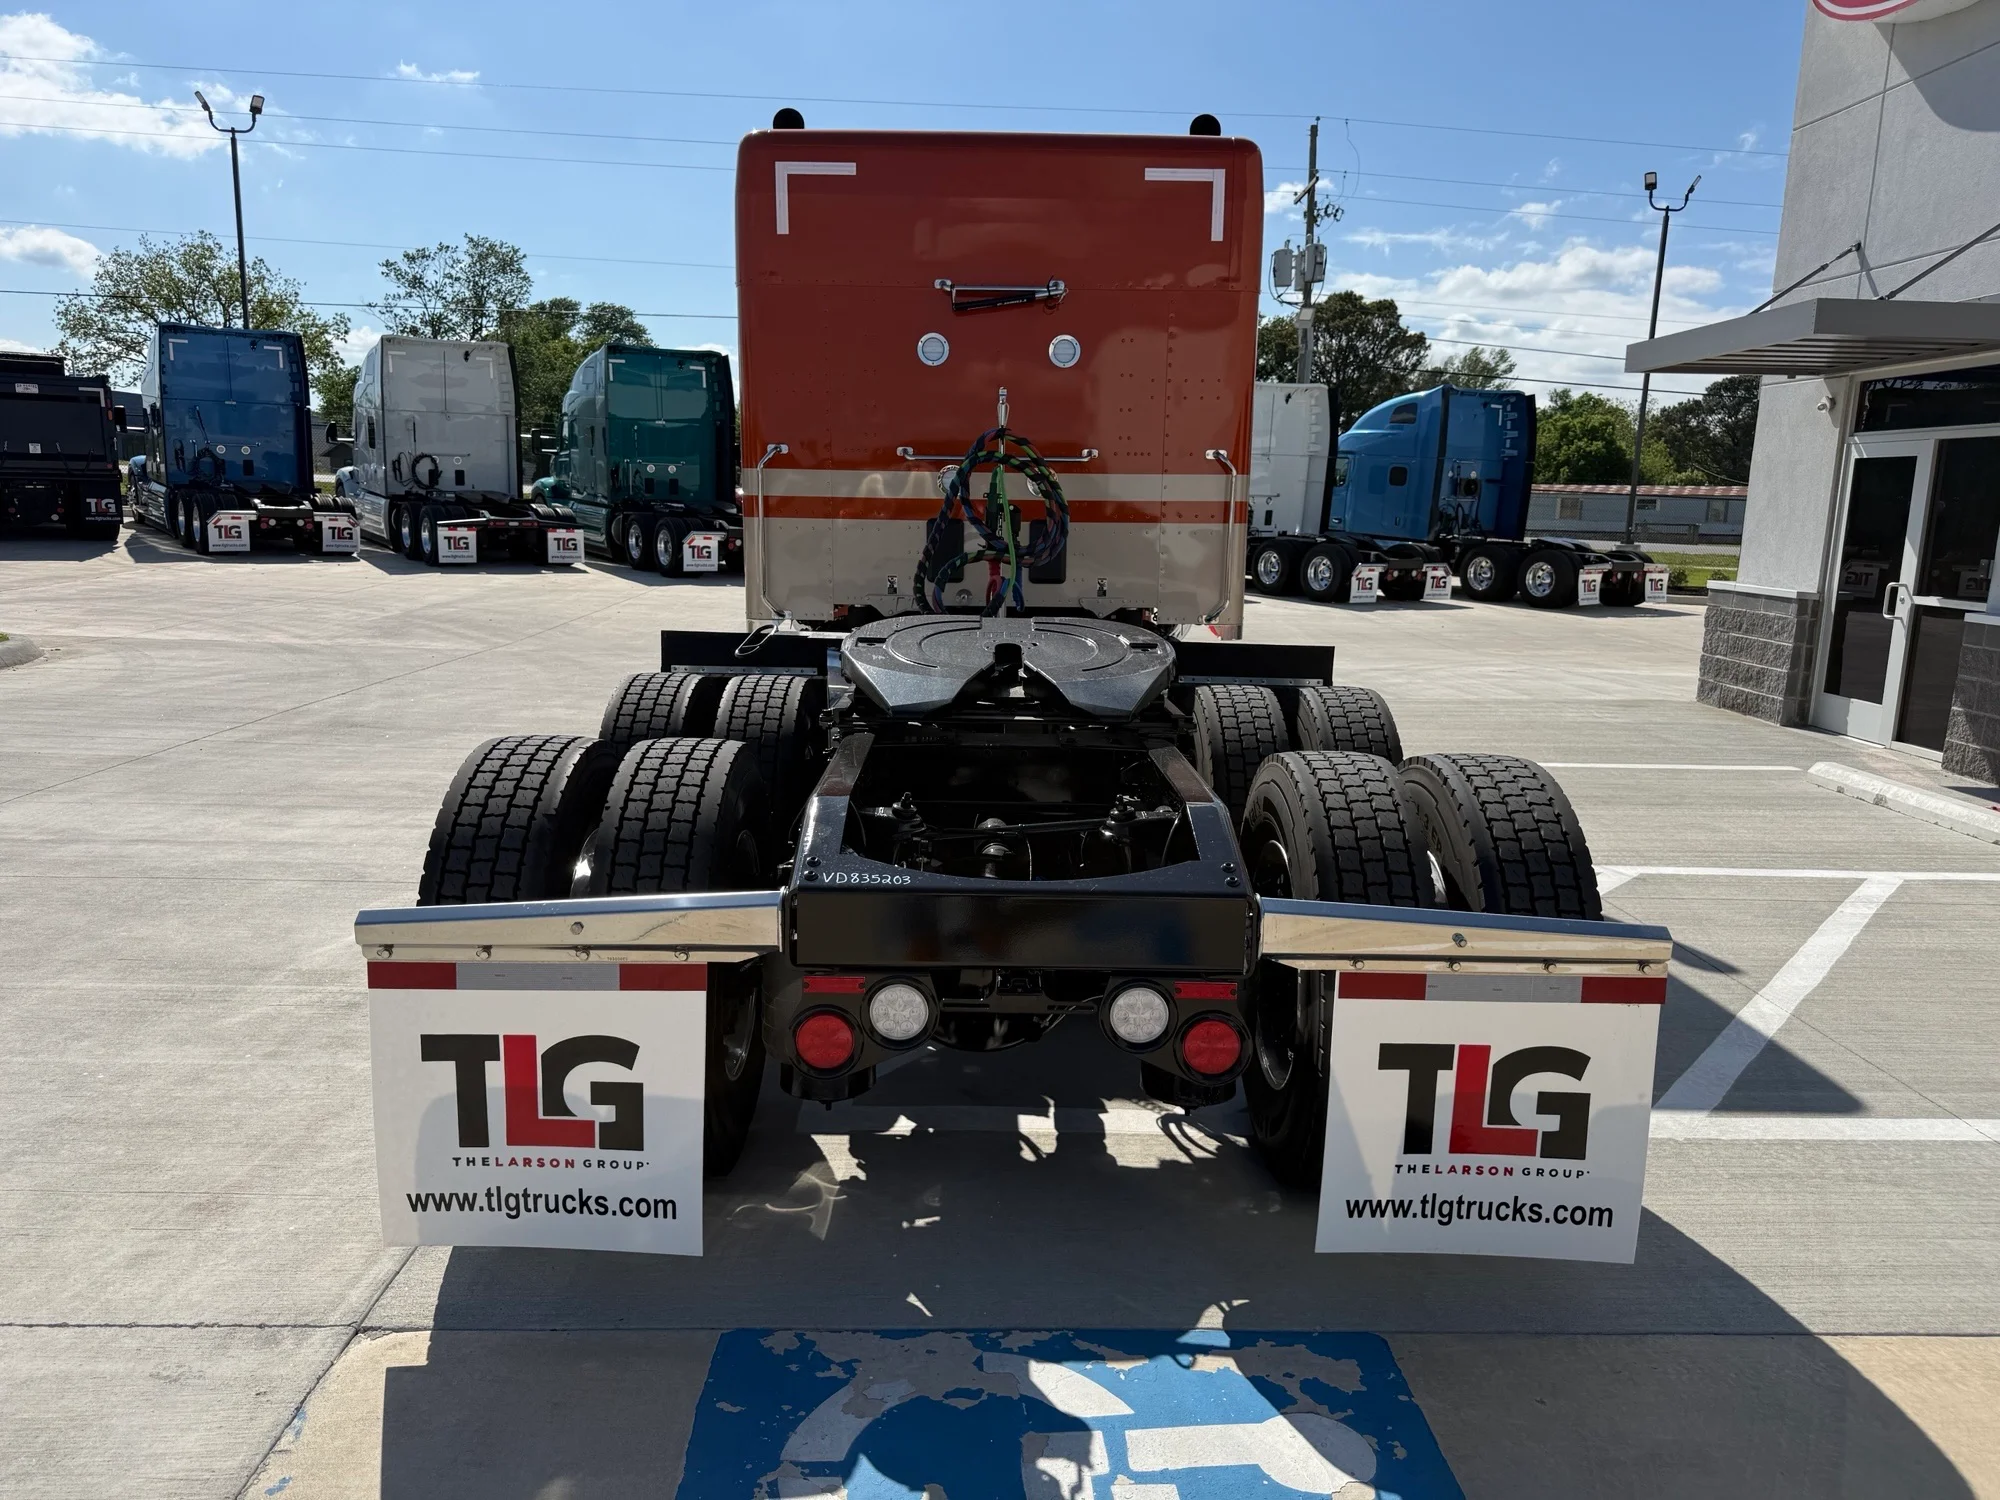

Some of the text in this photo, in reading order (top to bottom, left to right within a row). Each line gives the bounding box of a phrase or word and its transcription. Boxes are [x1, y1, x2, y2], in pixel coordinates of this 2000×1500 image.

[86, 498, 116, 513] TLG
[213, 525, 242, 539] TLG
[328, 526, 354, 540] TLG
[444, 536, 469, 550] TLG
[554, 538, 578, 551] TLG
[689, 545, 712, 559] TLG
[1356, 577, 1373, 590] TLG
[1431, 576, 1447, 589] TLG
[1582, 579, 1597, 592] TLG
[1649, 579, 1663, 592] TLG
[822, 872, 911, 885] VD835203
[420, 1034, 644, 1151] TLG
[1378, 1043, 1592, 1160] TLG
[406, 1186, 677, 1220] www.tlgtrucks.com
[1346, 1193, 1613, 1227] www.tlgtrucks.com
